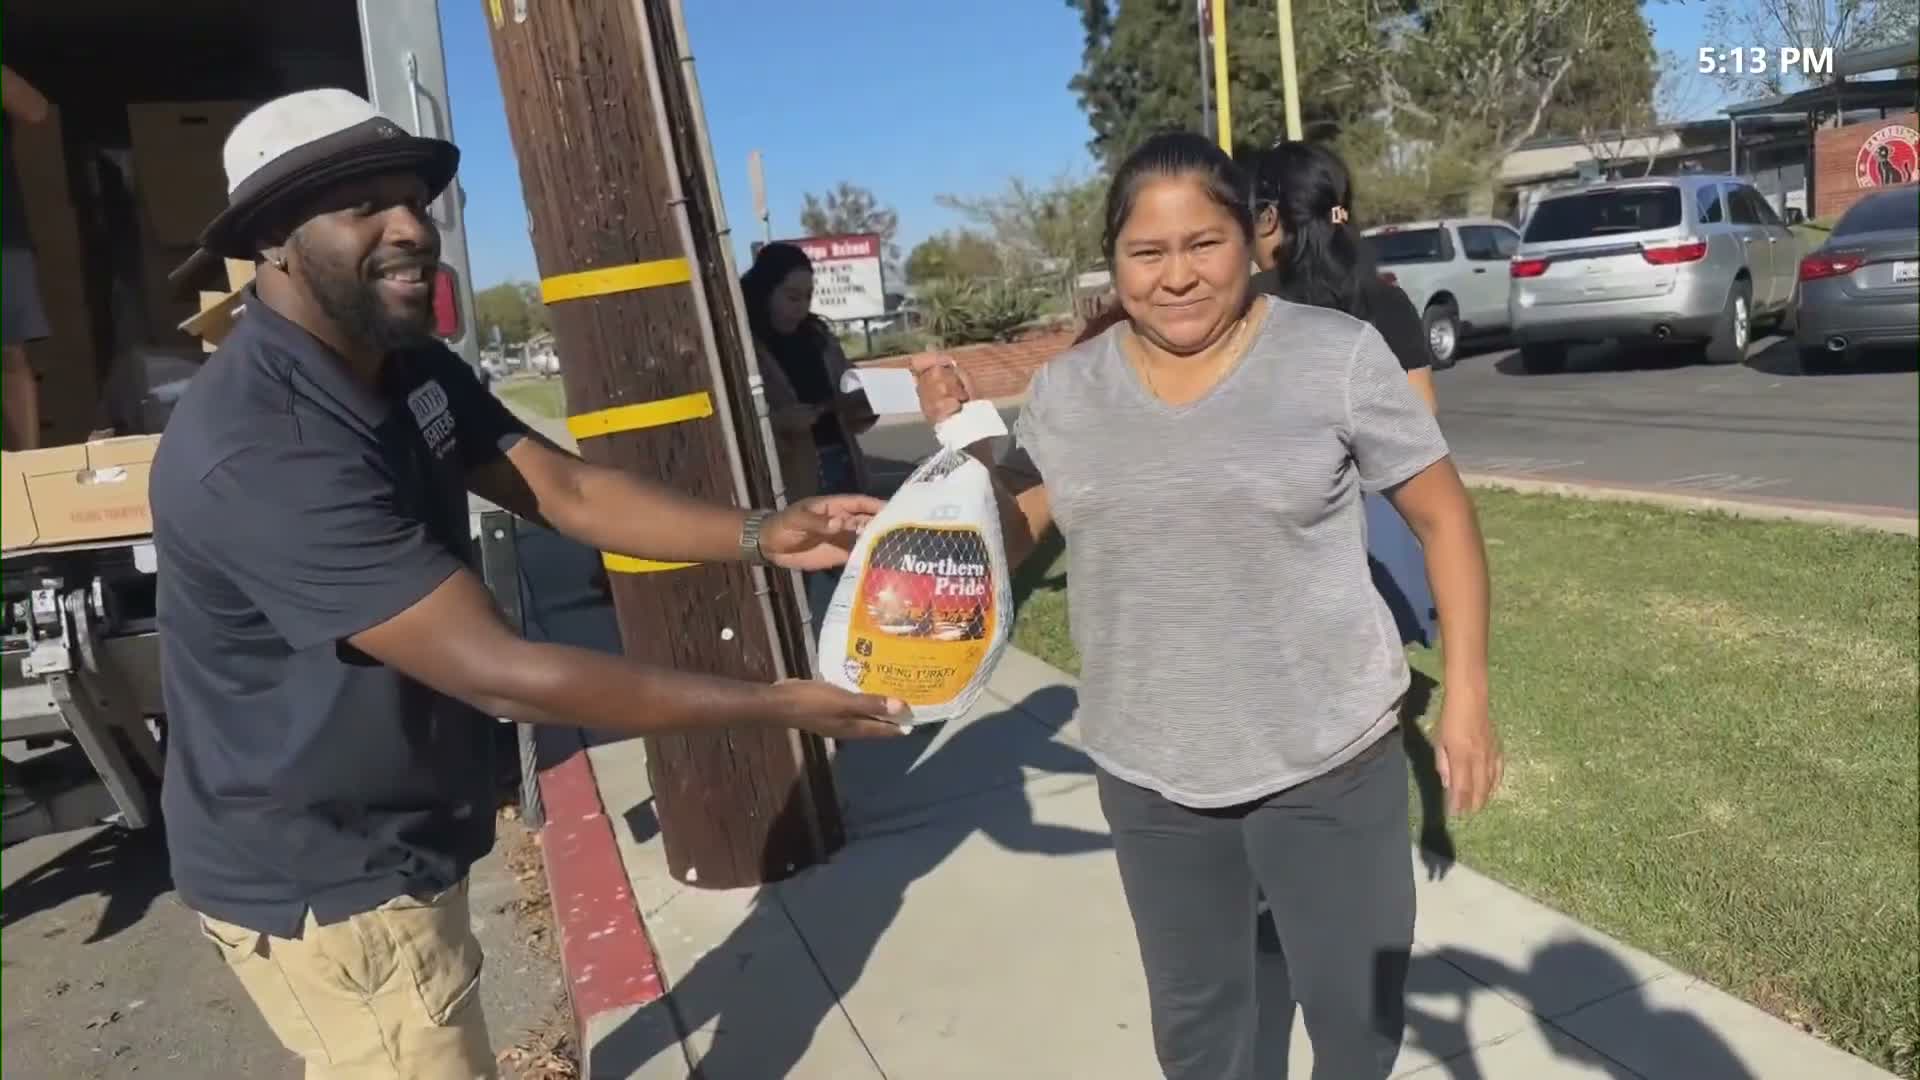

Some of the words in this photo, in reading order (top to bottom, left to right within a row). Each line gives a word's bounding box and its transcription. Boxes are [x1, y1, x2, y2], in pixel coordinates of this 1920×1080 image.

[901, 554, 984, 577] Northern
[934, 577, 985, 596] Pride
[876, 664, 912, 678] YOUNG
[917, 666, 958, 680] TURKEY
